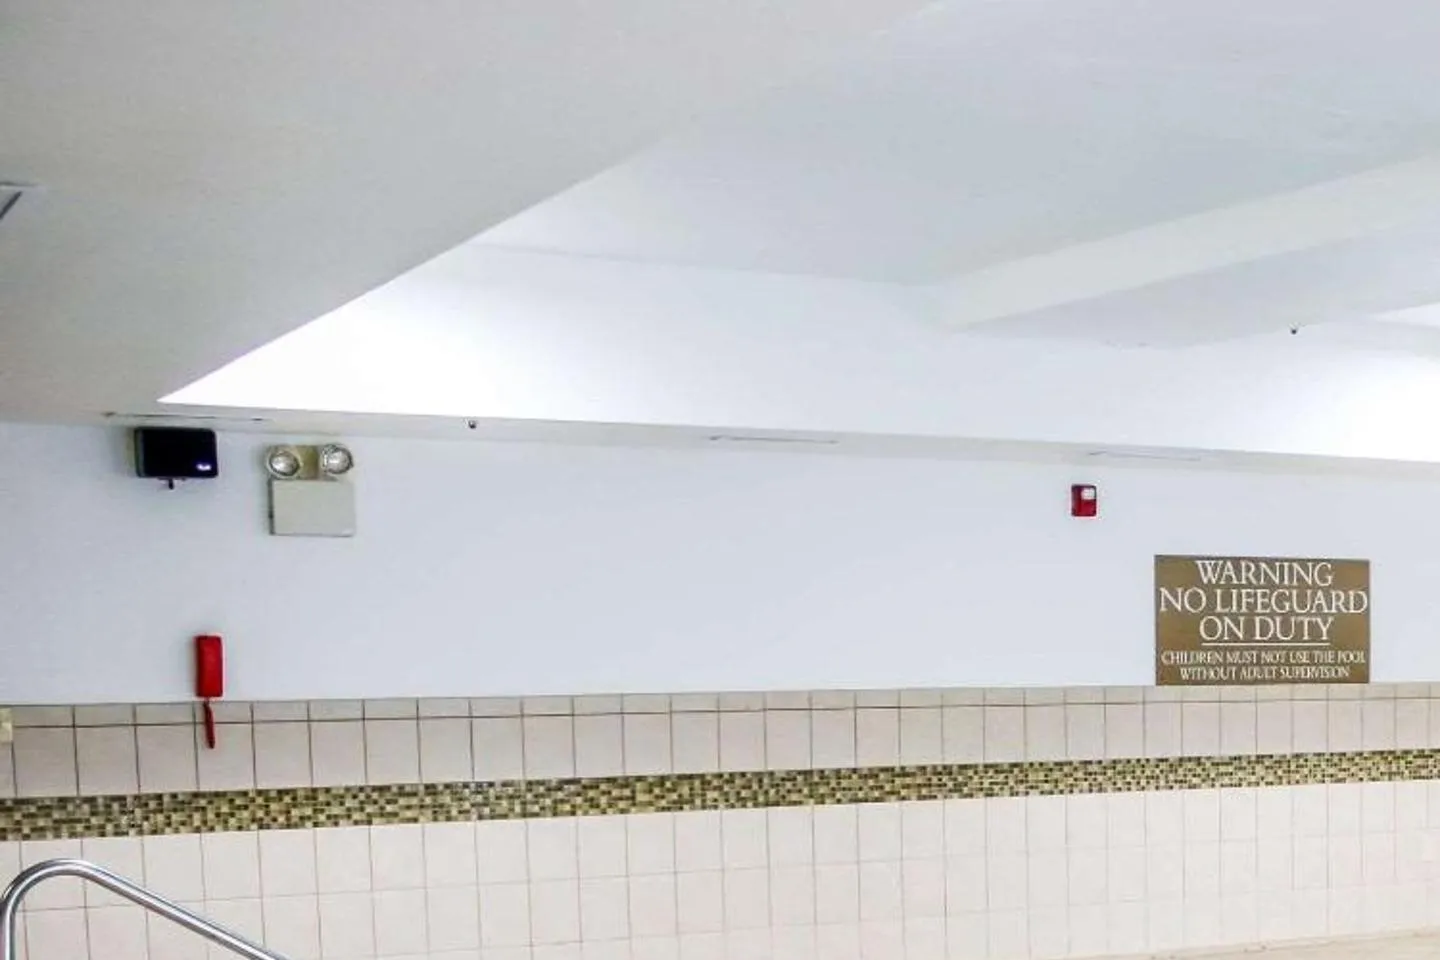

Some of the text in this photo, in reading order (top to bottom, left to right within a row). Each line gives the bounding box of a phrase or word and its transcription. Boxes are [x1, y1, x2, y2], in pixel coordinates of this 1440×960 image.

[1195, 560, 1333, 587] WARNING
[1159, 587, 1369, 614] NO LIFEGUARD
[1199, 615, 1335, 641] ON DUTY
[1160, 650, 1367, 665] CHILDREN MUST NOT USE THE POOL
[1180, 665, 1351, 681] WITHOUT ADULT SUPERVISION
